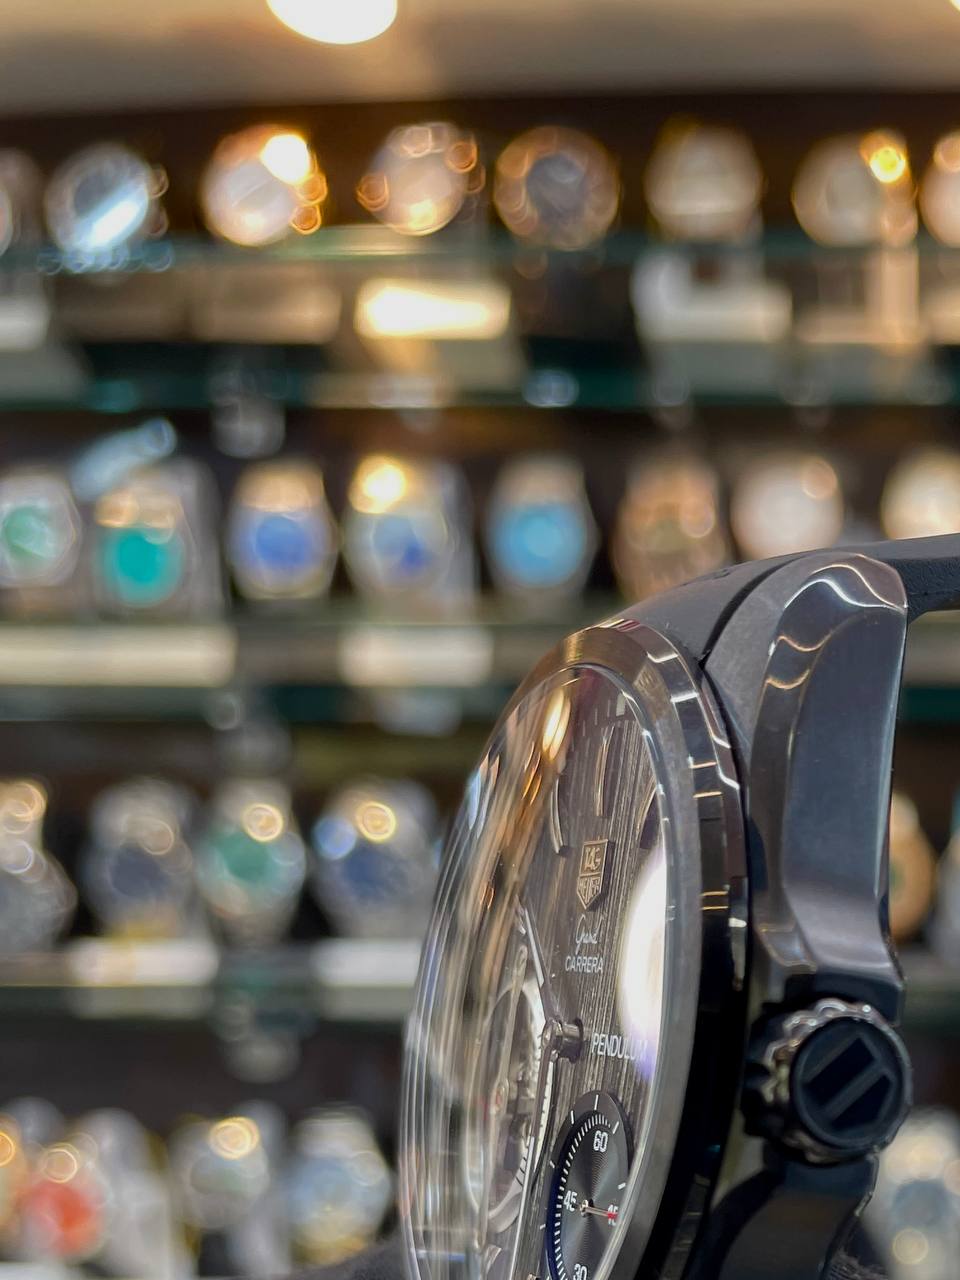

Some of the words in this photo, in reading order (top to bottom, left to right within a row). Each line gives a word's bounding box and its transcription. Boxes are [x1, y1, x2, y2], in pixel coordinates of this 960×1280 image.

[564, 955, 604, 974] CARRERA
[593, 1130, 609, 1153] 60
[563, 1190, 578, 1212] 45
